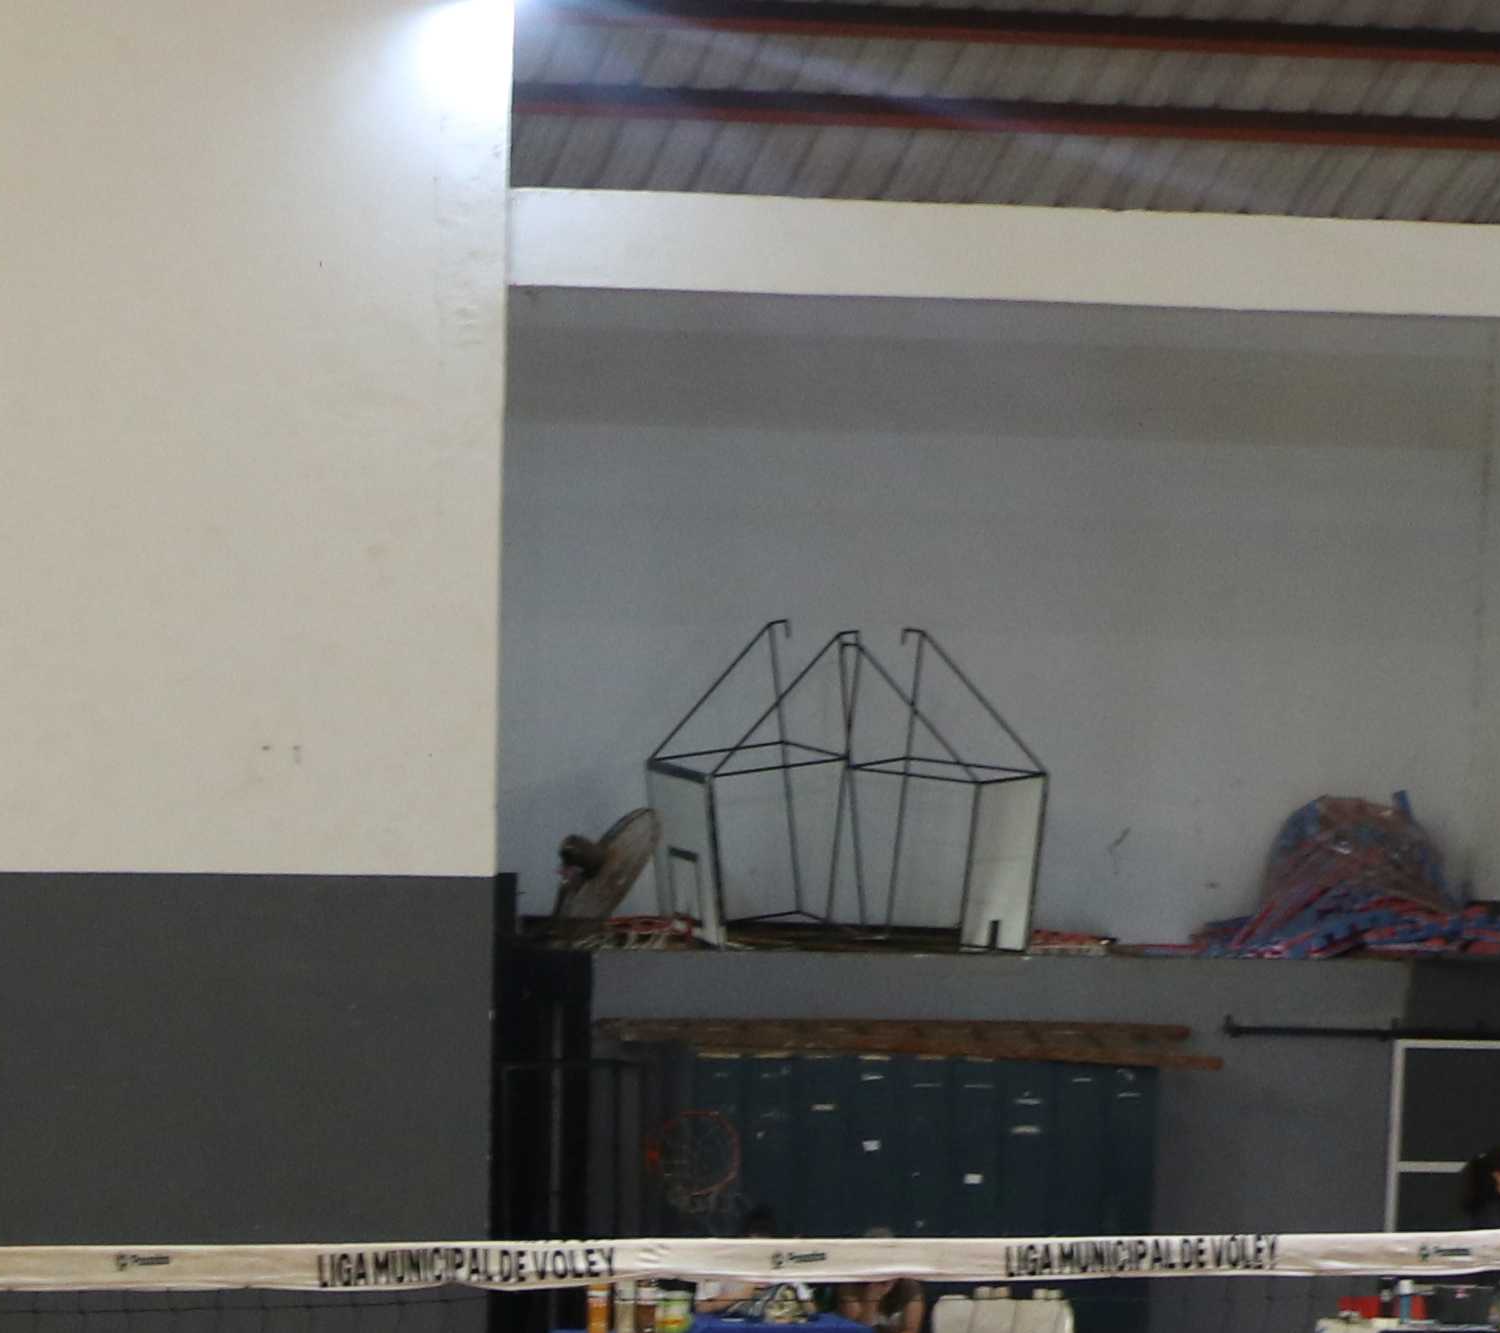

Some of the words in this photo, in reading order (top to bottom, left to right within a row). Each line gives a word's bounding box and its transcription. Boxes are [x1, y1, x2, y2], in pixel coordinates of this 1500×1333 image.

[317, 1253, 369, 1288] LIGA
[373, 1248, 496, 1285] MUNICIPAL
[501, 1250, 528, 1283] DE
[533, 1247, 617, 1280] VOLEY
[1005, 1245, 1052, 1278] LIGA
[1058, 1238, 1176, 1276] MUNICIPAL
[1179, 1237, 1206, 1270] DE
[1213, 1234, 1279, 1270] VOLEY
